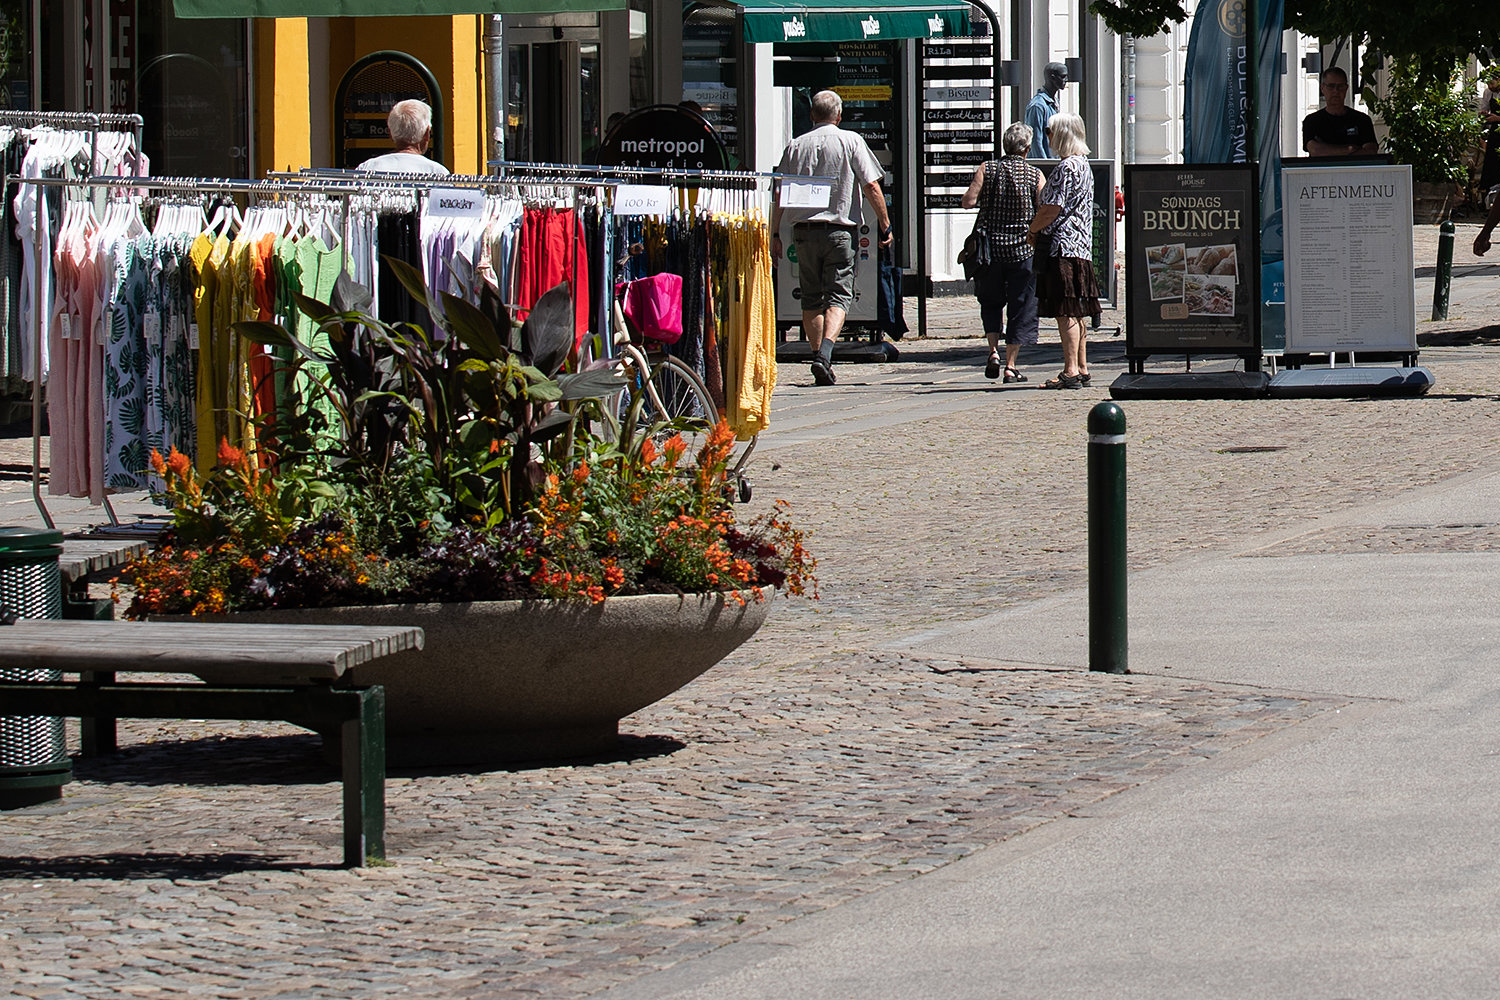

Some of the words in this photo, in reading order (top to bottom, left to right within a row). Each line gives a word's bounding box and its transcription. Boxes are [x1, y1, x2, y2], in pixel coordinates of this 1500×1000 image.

[948, 88, 980, 100] Bisque
[621, 138, 705, 156] metropol
[1299, 184, 1395, 200] AFTENMENU
[625, 199, 644, 207] 100
[646, 199, 659, 207] kr
[1161, 196, 1222, 208] SØNDAGS
[1143, 210, 1241, 230] BRUNCH
